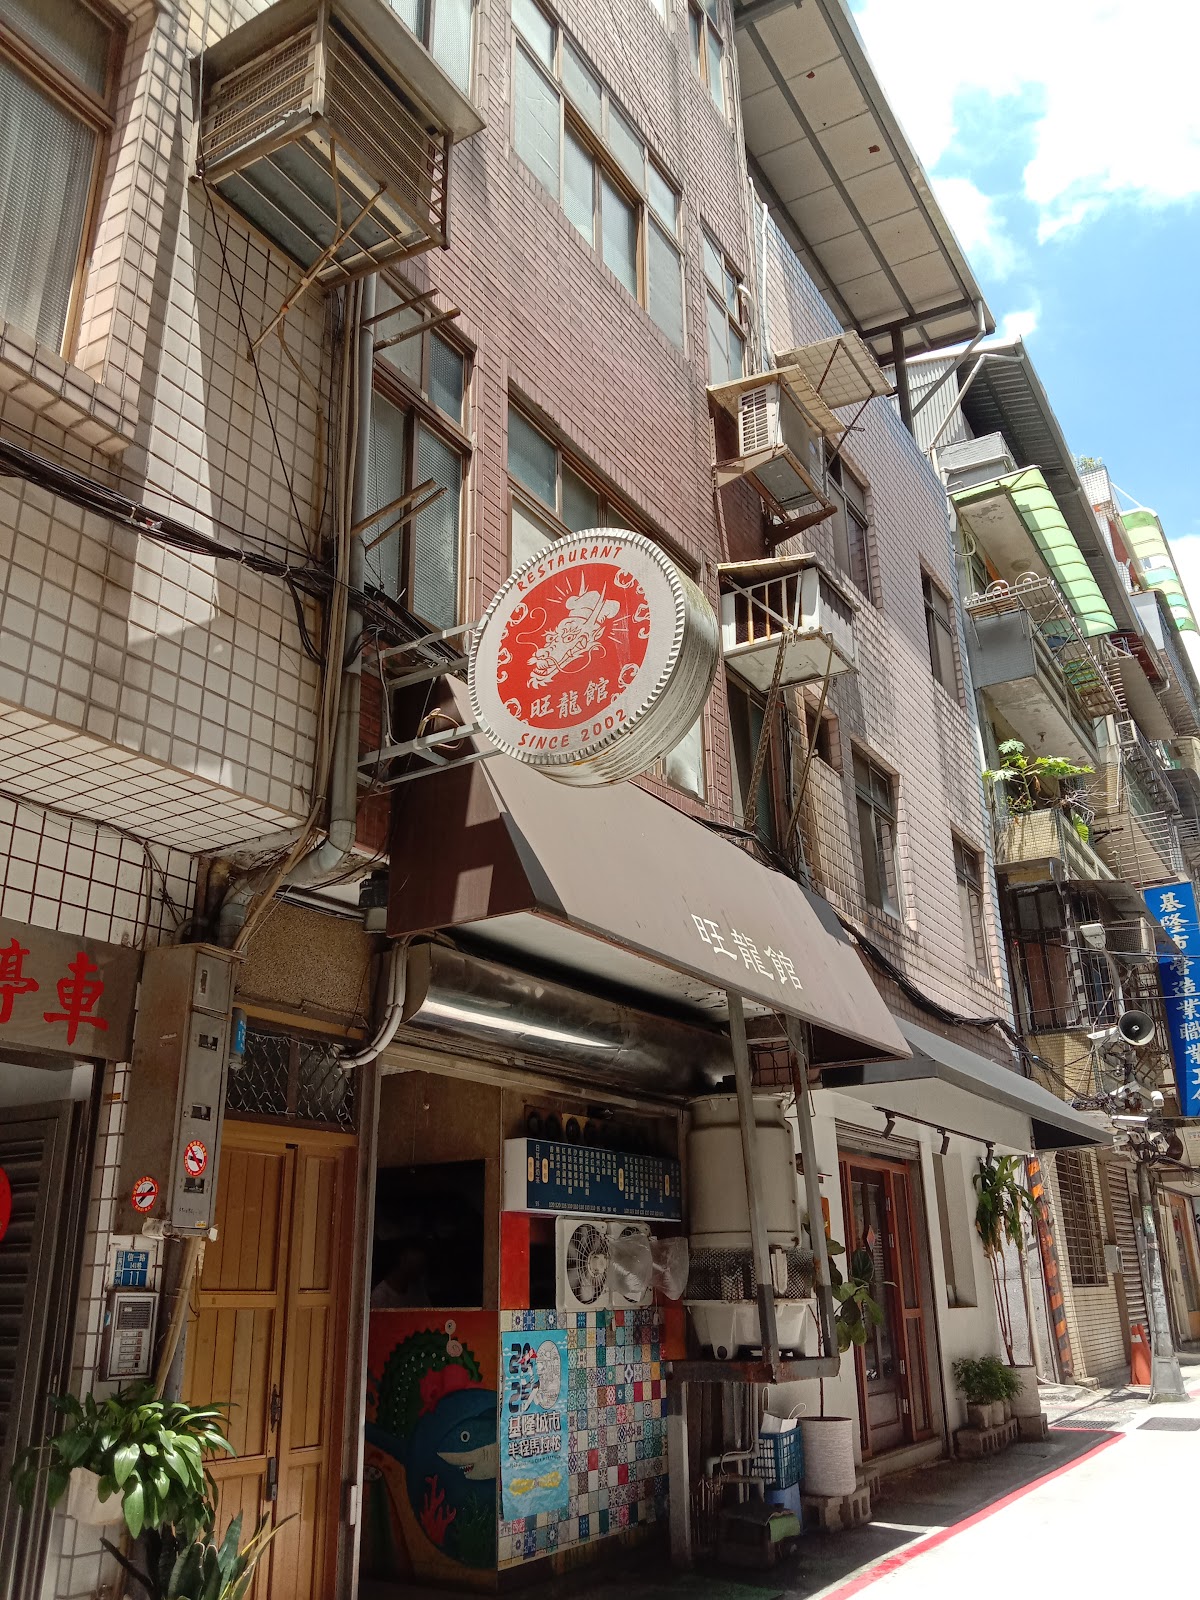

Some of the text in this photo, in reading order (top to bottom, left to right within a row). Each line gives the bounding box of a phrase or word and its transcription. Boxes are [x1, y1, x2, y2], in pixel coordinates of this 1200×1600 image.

[517, 545, 622, 592] RESTAURANT
[530, 677, 610, 718] 旺龍館
[518, 708, 627, 749] SINCE 2002
[691, 913, 803, 990] 旺龍館
[128, 1270, 140, 1286] 11
[509, 1412, 560, 1439] 基隆城市
[509, 1435, 561, 1458] 半程馬拉松
